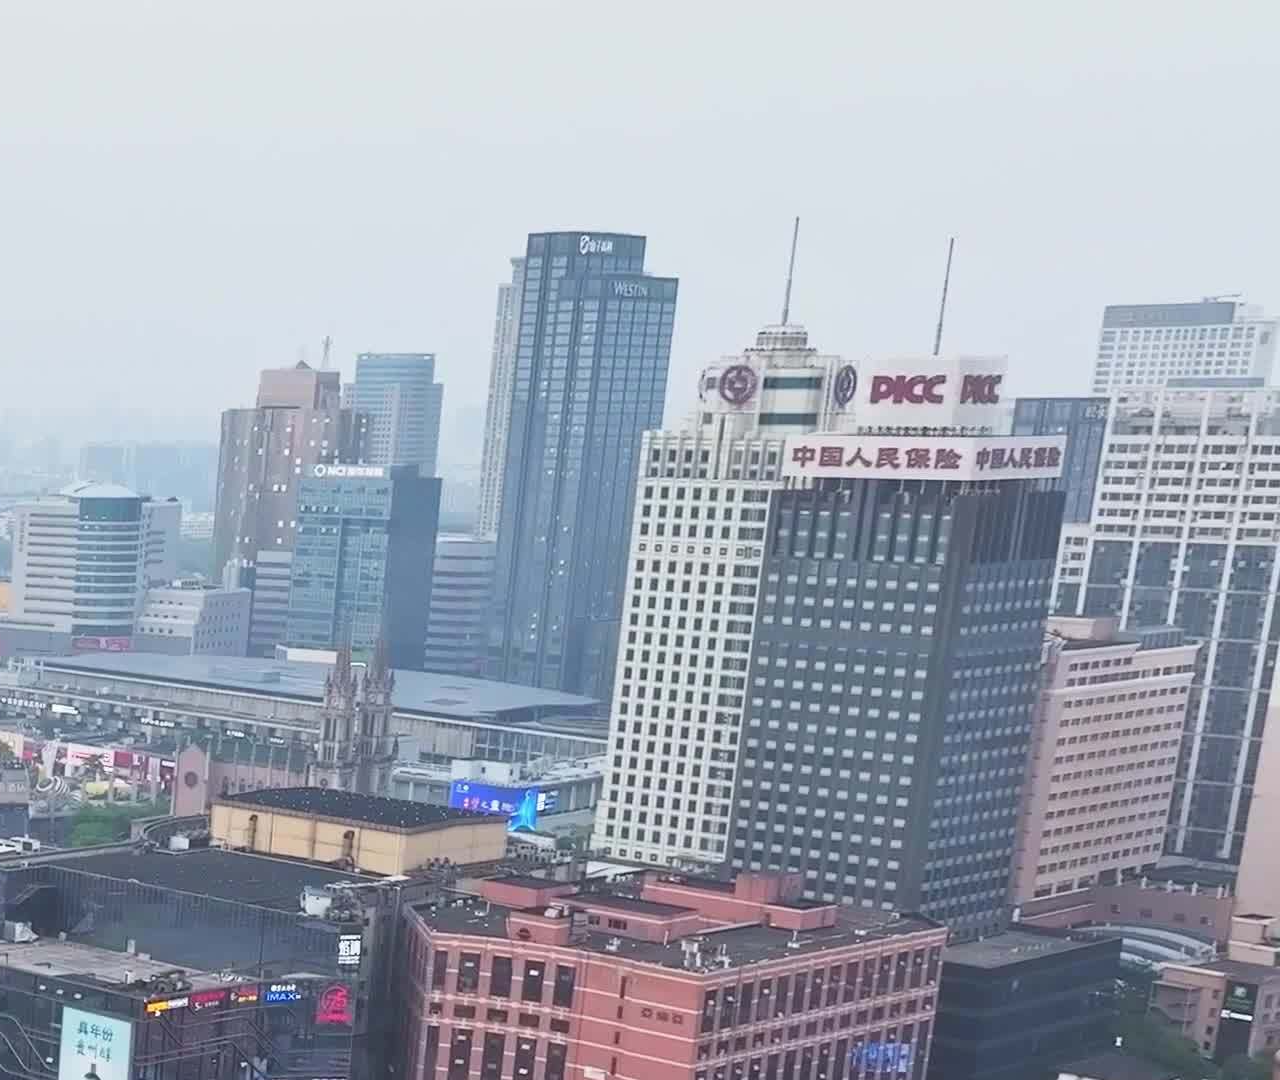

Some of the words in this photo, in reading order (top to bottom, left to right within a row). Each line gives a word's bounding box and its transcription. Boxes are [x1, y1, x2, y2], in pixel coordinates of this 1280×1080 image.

[614, 281, 648, 296] WESTIN
[869, 375, 946, 404] PICC
[959, 374, 1003, 404] PICC
[792, 445, 962, 471] 中国人民保险
[975, 447, 1061, 471] 中国人民保险
[266, 992, 296, 1001] IMAX
